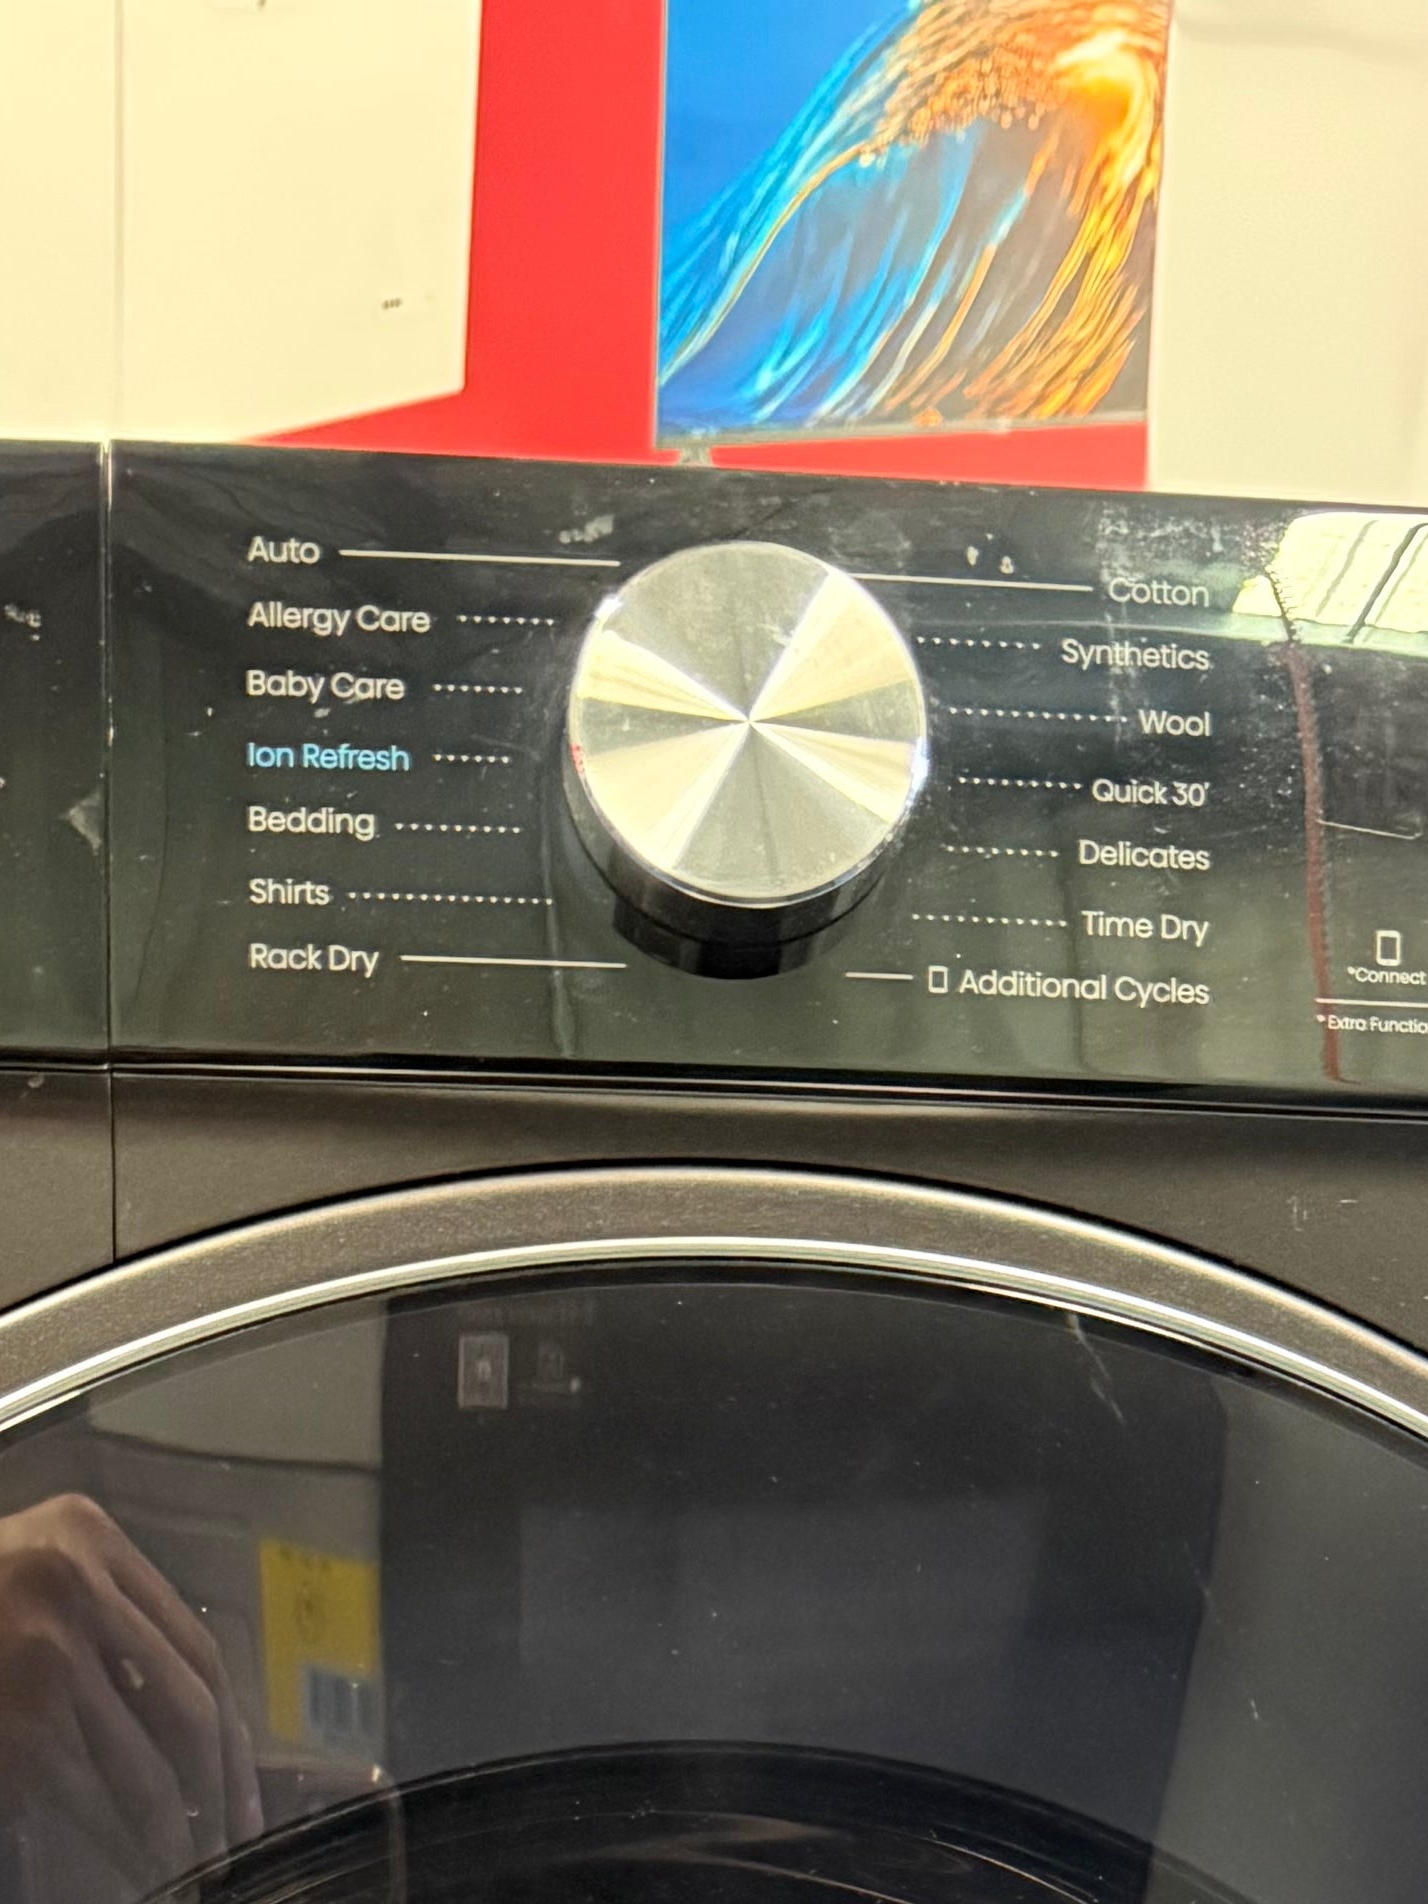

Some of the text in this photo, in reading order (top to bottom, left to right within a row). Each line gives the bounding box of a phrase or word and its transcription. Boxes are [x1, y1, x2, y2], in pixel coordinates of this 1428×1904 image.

[247, 536, 320, 565] Auto
[1108, 577, 1210, 607] Cotton
[247, 602, 431, 636] Allergy Care
[1061, 639, 1211, 670] Synthetics
[247, 670, 405, 702] Baby Care
[1138, 709, 1211, 737] Wool
[247, 742, 410, 771] Ion Refresh
[1092, 779, 1169, 806] Quick
[248, 807, 375, 840] Bedding
[1078, 840, 1210, 870] Delicates
[249, 878, 329, 906] Shirts
[1081, 911, 1209, 946] Time Dry
[249, 944, 378, 977] Rack Dry
[959, 970, 1210, 1008] Additional Cycles
